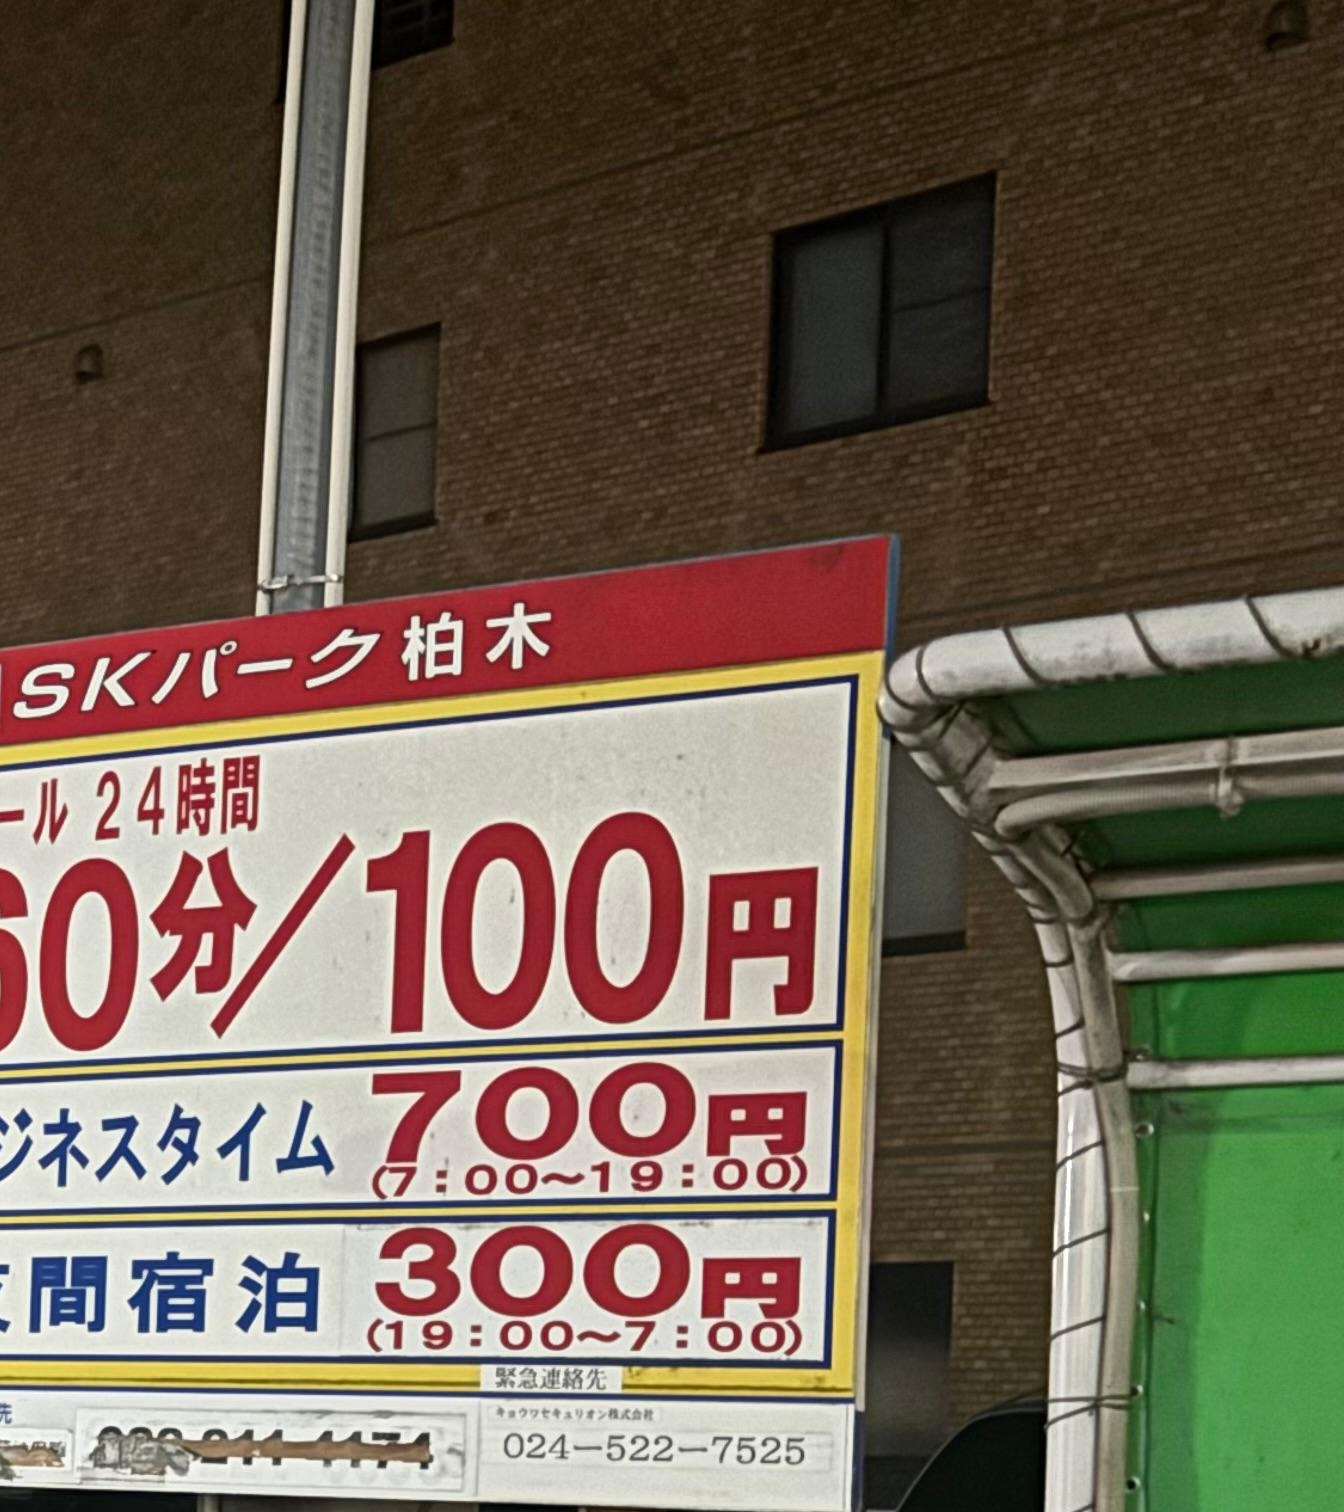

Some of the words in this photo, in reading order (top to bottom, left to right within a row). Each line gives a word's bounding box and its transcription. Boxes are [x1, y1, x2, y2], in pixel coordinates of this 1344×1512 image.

[13, 602, 552, 718] SKパーク柏木
[95, 755, 261, 841] 24時間
[372, 1062, 807, 1163] 700円
[375, 1223, 802, 1318] 300円
[495, 1366, 608, 1391] 緊急連絡先
[496, 1406, 654, 1422] キョウワセキュリオン株式会社
[503, 1432, 806, 1466] 024-522-7525
